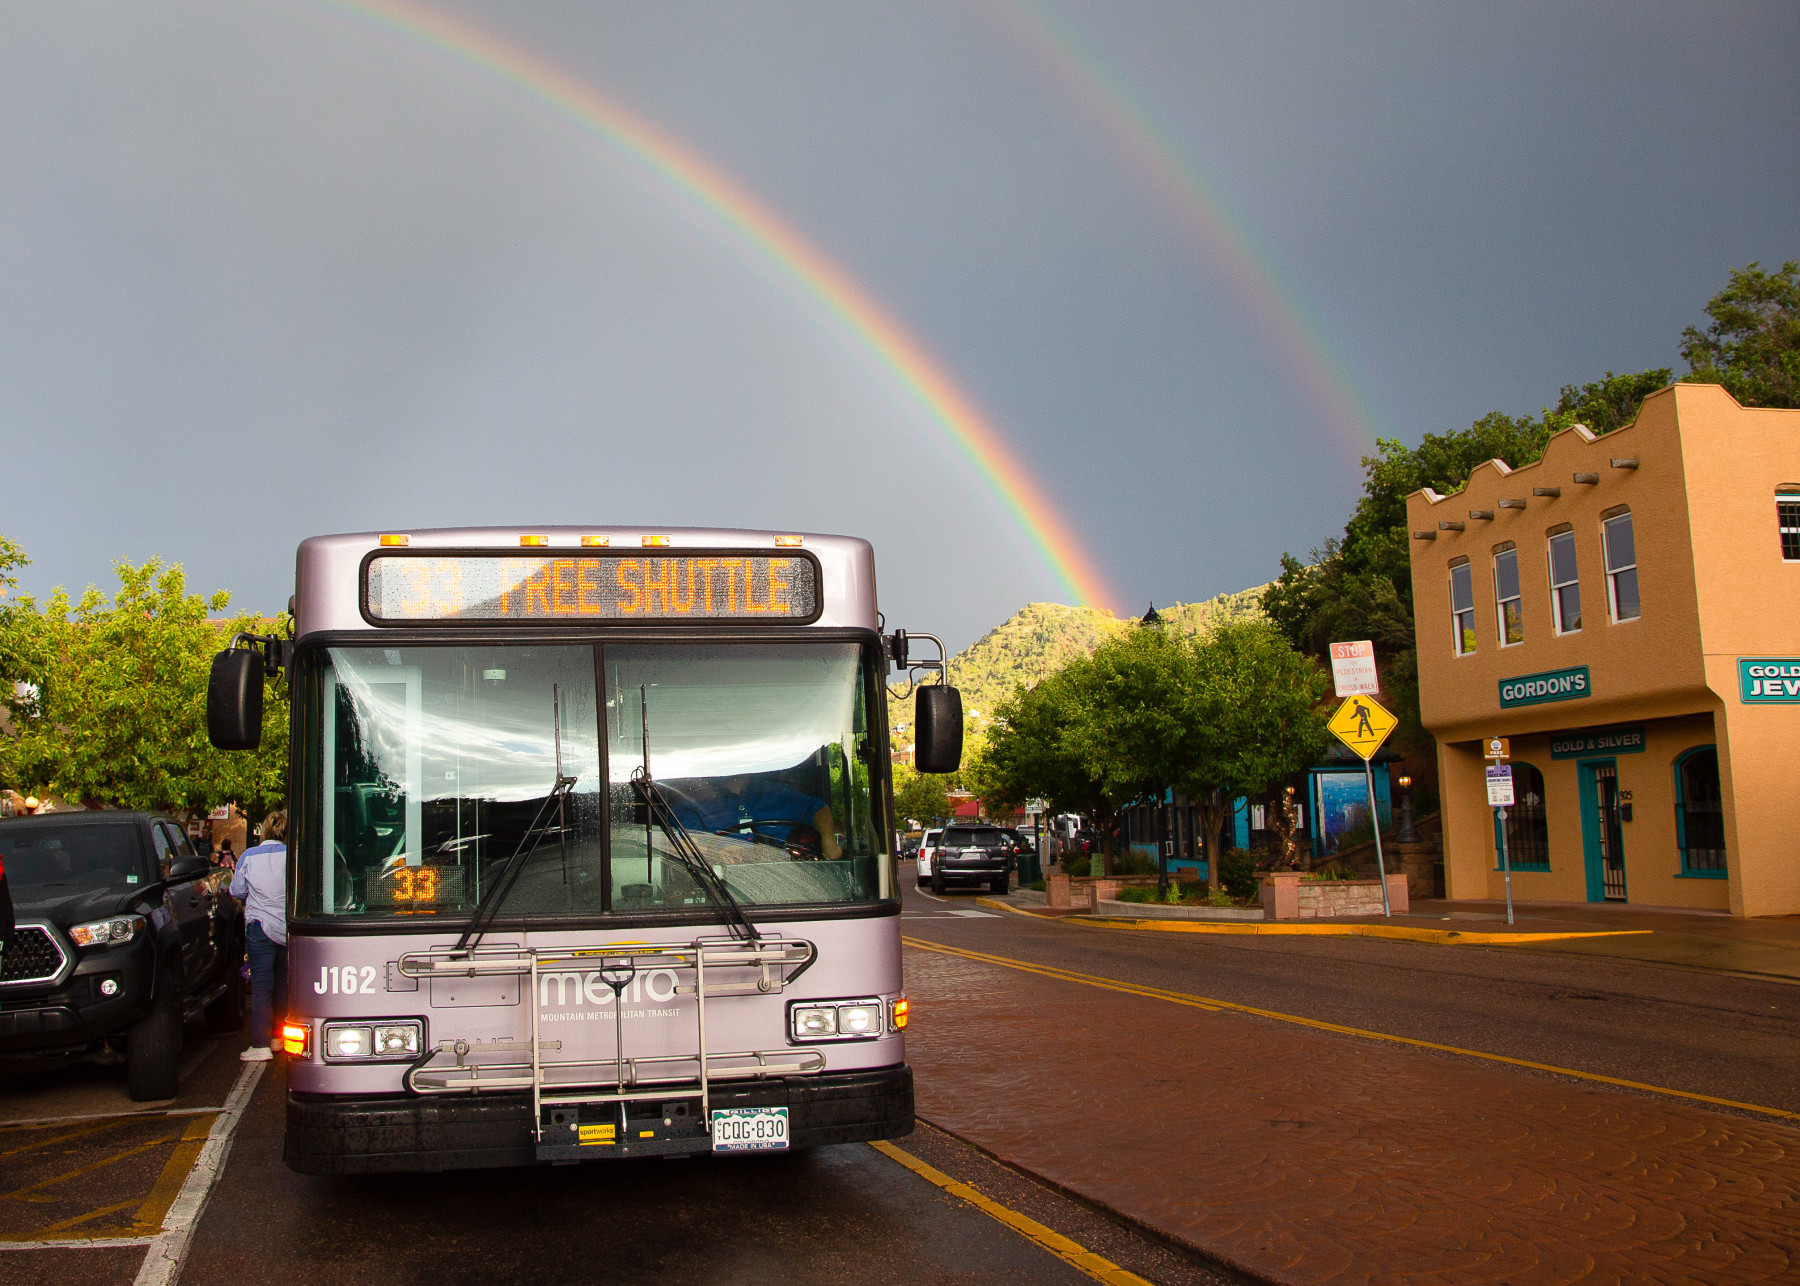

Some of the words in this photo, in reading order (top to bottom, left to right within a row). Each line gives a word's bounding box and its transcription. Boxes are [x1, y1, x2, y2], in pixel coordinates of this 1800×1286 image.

[400, 560, 463, 614] 33
[501, 559, 600, 614] FREE
[617, 559, 790, 613] SHUTTLE
[1338, 644, 1365, 658] STOP
[1336, 667, 1372, 676] PEDESTRIAN
[1748, 665, 1800, 678] GOLD
[1338, 684, 1357, 692] CROSS
[1502, 673, 1586, 701] GORDON'S
[1553, 740, 1585, 753] GOLD
[1586, 738, 1596, 750] &
[1598, 733, 1641, 749] SILVER
[394, 868, 435, 900] 33
[313, 965, 377, 995] J162
[541, 959, 680, 1007] metro
[540, 1011, 585, 1022] MOUNTAIN
[648, 1008, 680, 1017] TRANSIT
[580, 1128, 614, 1136] sportworks
